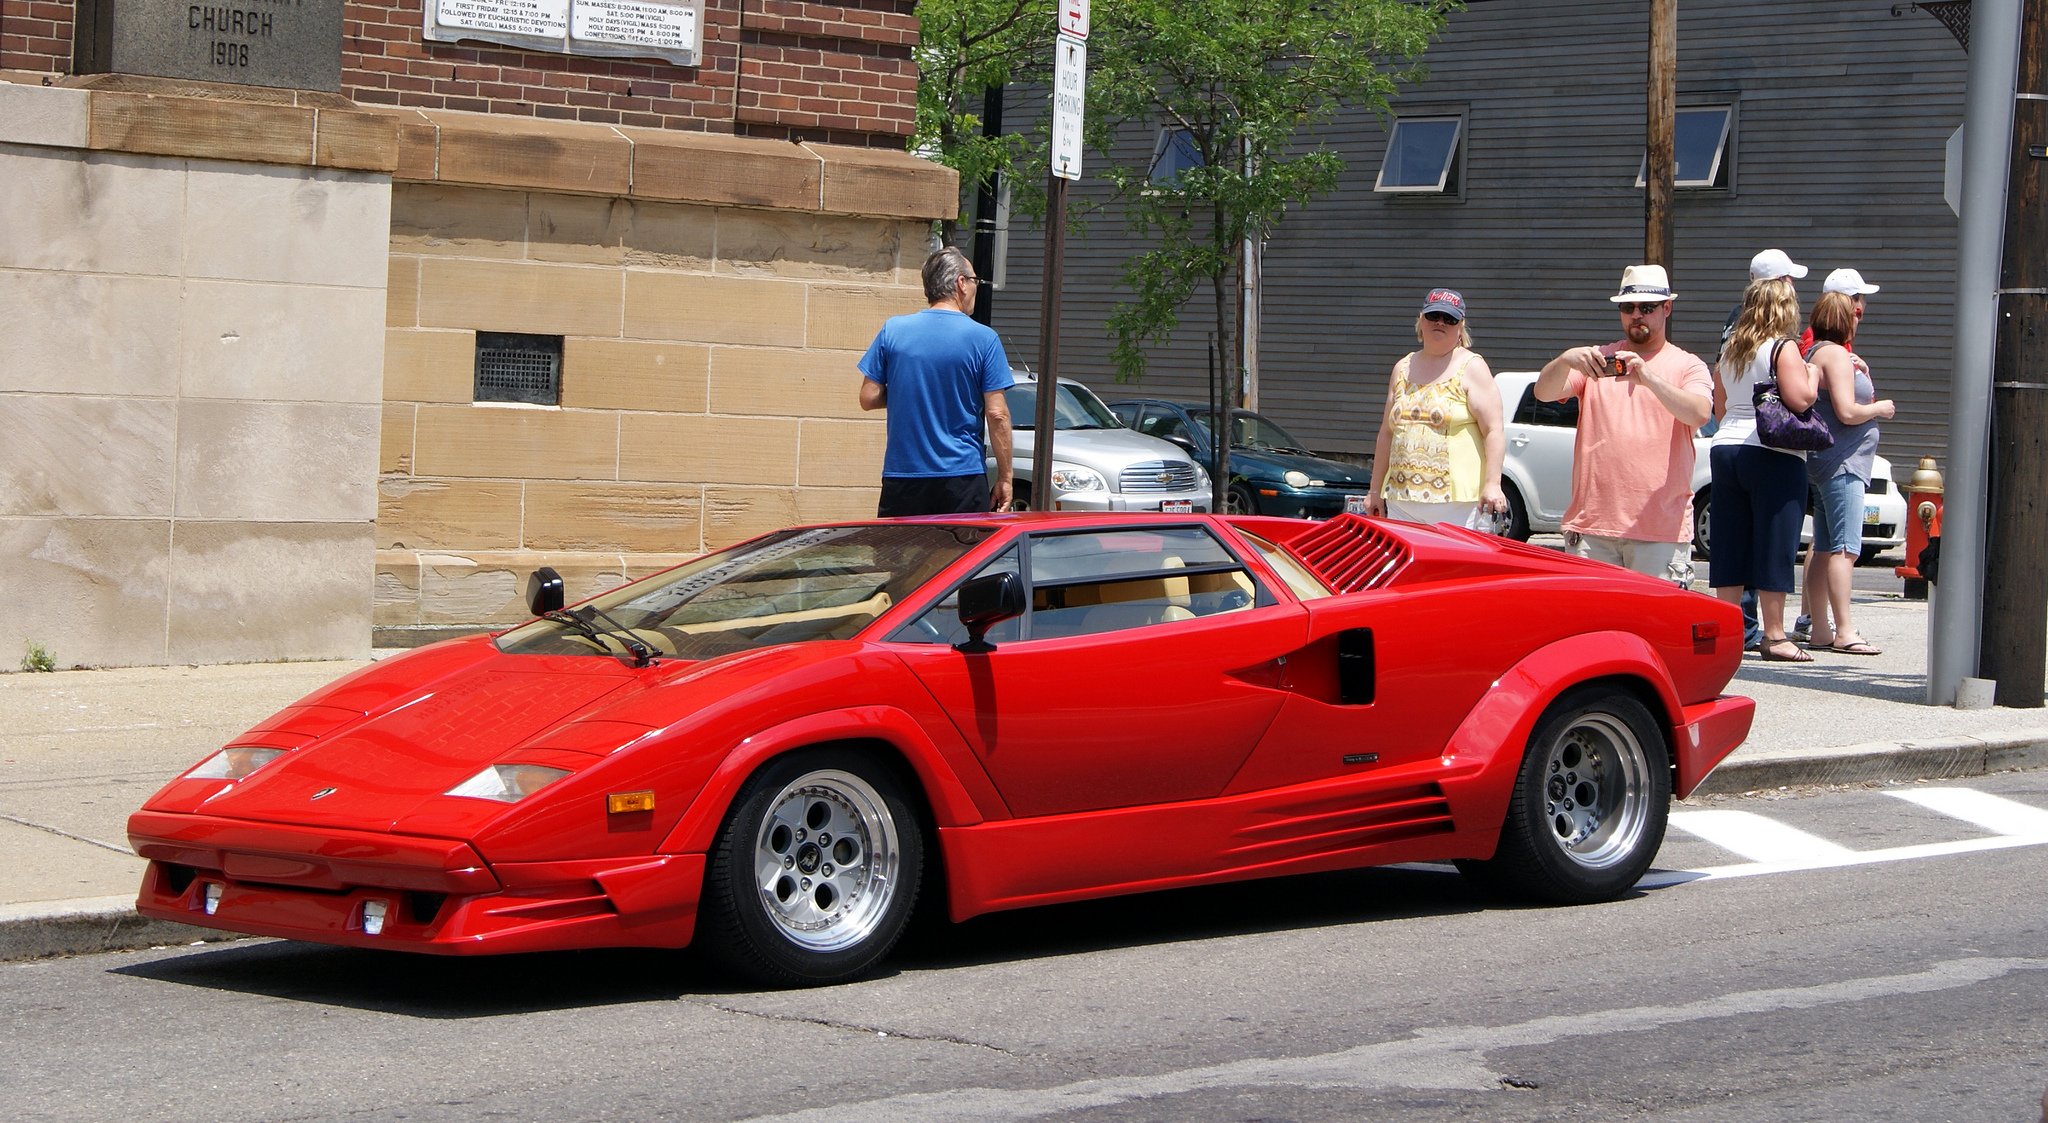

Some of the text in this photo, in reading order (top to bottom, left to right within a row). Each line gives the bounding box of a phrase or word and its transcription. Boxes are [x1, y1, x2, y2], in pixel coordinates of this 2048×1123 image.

[188, 5, 274, 37] CHURCH
[440, 9, 477, 19] FOLLOWED
[487, 13, 531, 24] EUCHARISTIC
[530, 19, 567, 29] DEVOTIONS
[476, 5, 499, 13] FRIDAY
[503, 8, 518, 16] 12:15
[525, 10, 539, 18] 7:00
[588, 16, 604, 24] HOLY
[474, 20, 498, 29] (VIGIL)
[499, 23, 517, 31] MASS
[518, 25, 532, 33] 5:00
[210, 40, 250, 68] 1908
[1061, 69, 1078, 92] HOUR
[1058, 92, 1081, 116] PARKING
